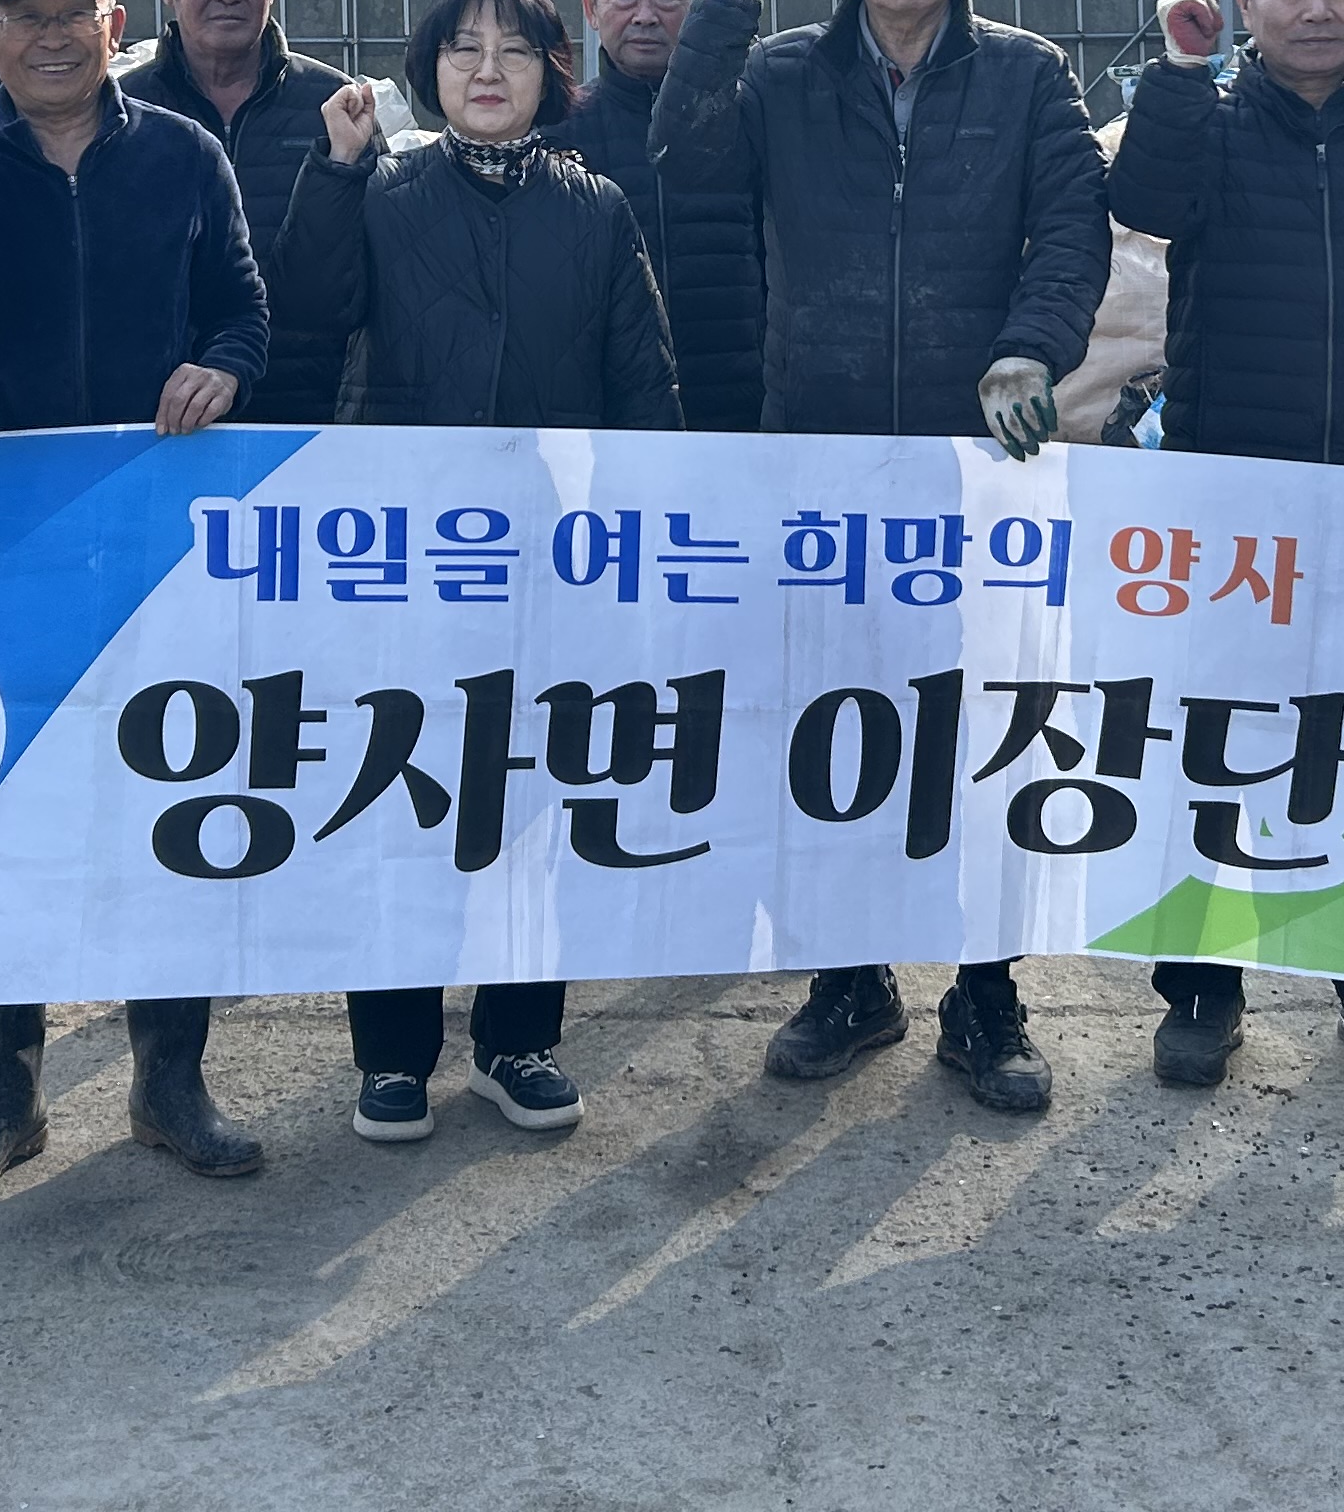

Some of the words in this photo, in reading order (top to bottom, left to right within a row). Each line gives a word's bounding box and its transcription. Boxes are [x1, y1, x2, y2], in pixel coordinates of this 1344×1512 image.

[201, 506, 520, 602] 내일을
[552, 509, 750, 603] 여는
[777, 510, 1073, 607] 희망의
[1109, 526, 1305, 626] 양사
[117, 669, 726, 879] 양사면
